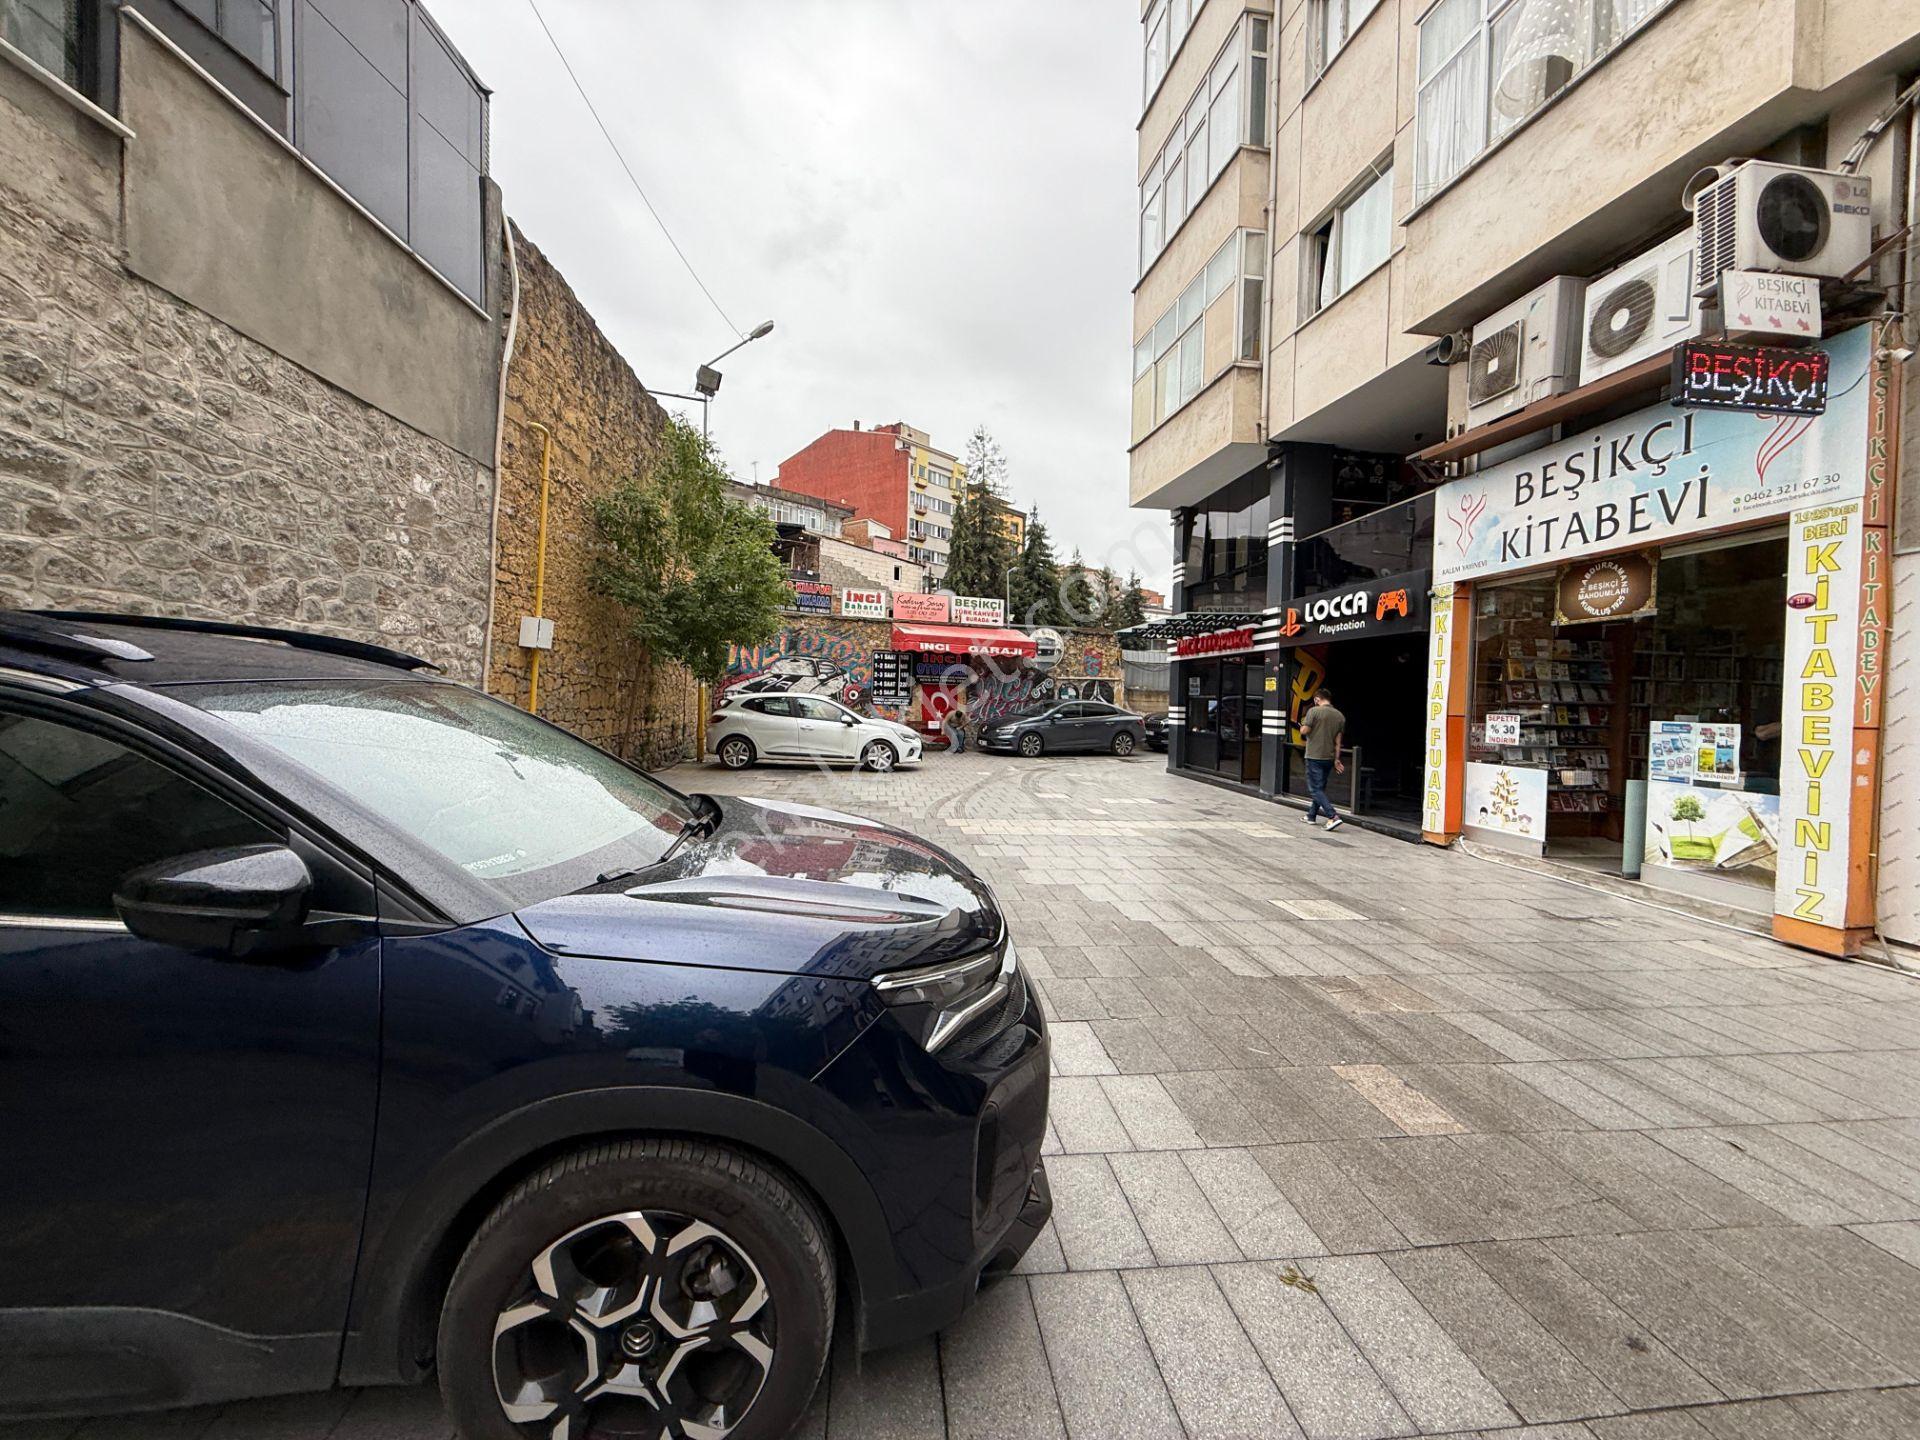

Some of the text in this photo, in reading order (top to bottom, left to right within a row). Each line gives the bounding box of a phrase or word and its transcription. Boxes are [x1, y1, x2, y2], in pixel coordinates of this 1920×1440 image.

[1833, 203, 1870, 215] BEKO
[1758, 277, 1806, 297] BEŞİKÇİ
[1755, 294, 1811, 315] KİTABEVİ
[1691, 350, 1822, 406] BEŞİKÇİ
[1514, 411, 1696, 508] BEŞİKÇİ
[1744, 473, 1840, 503] 0462 321 67 30
[1501, 464, 1711, 562] KİTABEVİ
[1802, 517, 1848, 541] BERİ
[1577, 587, 1629, 601] MAHDUMLARI
[1588, 578, 1619, 591] BEŞİKÇİ
[844, 602, 883, 611] Baharat
[955, 598, 1002, 612] BEŞİKÇİ
[955, 608, 1002, 618] TÜRK KAHVESİ
[1304, 591, 1368, 622] LOCCA
[1580, 595, 1626, 616] KURULUŞ 1925
[1319, 620, 1366, 635] Playstation
[1858, 531, 1883, 724] KİTABEVİ
[1031, 677, 1054, 699] OTO
[1426, 614, 1447, 831] KİTAP FUARI
[1490, 724, 1500, 734] %
[1503, 725, 1516, 734] 30
[1793, 541, 1843, 922] KİTABEVİNİZ
